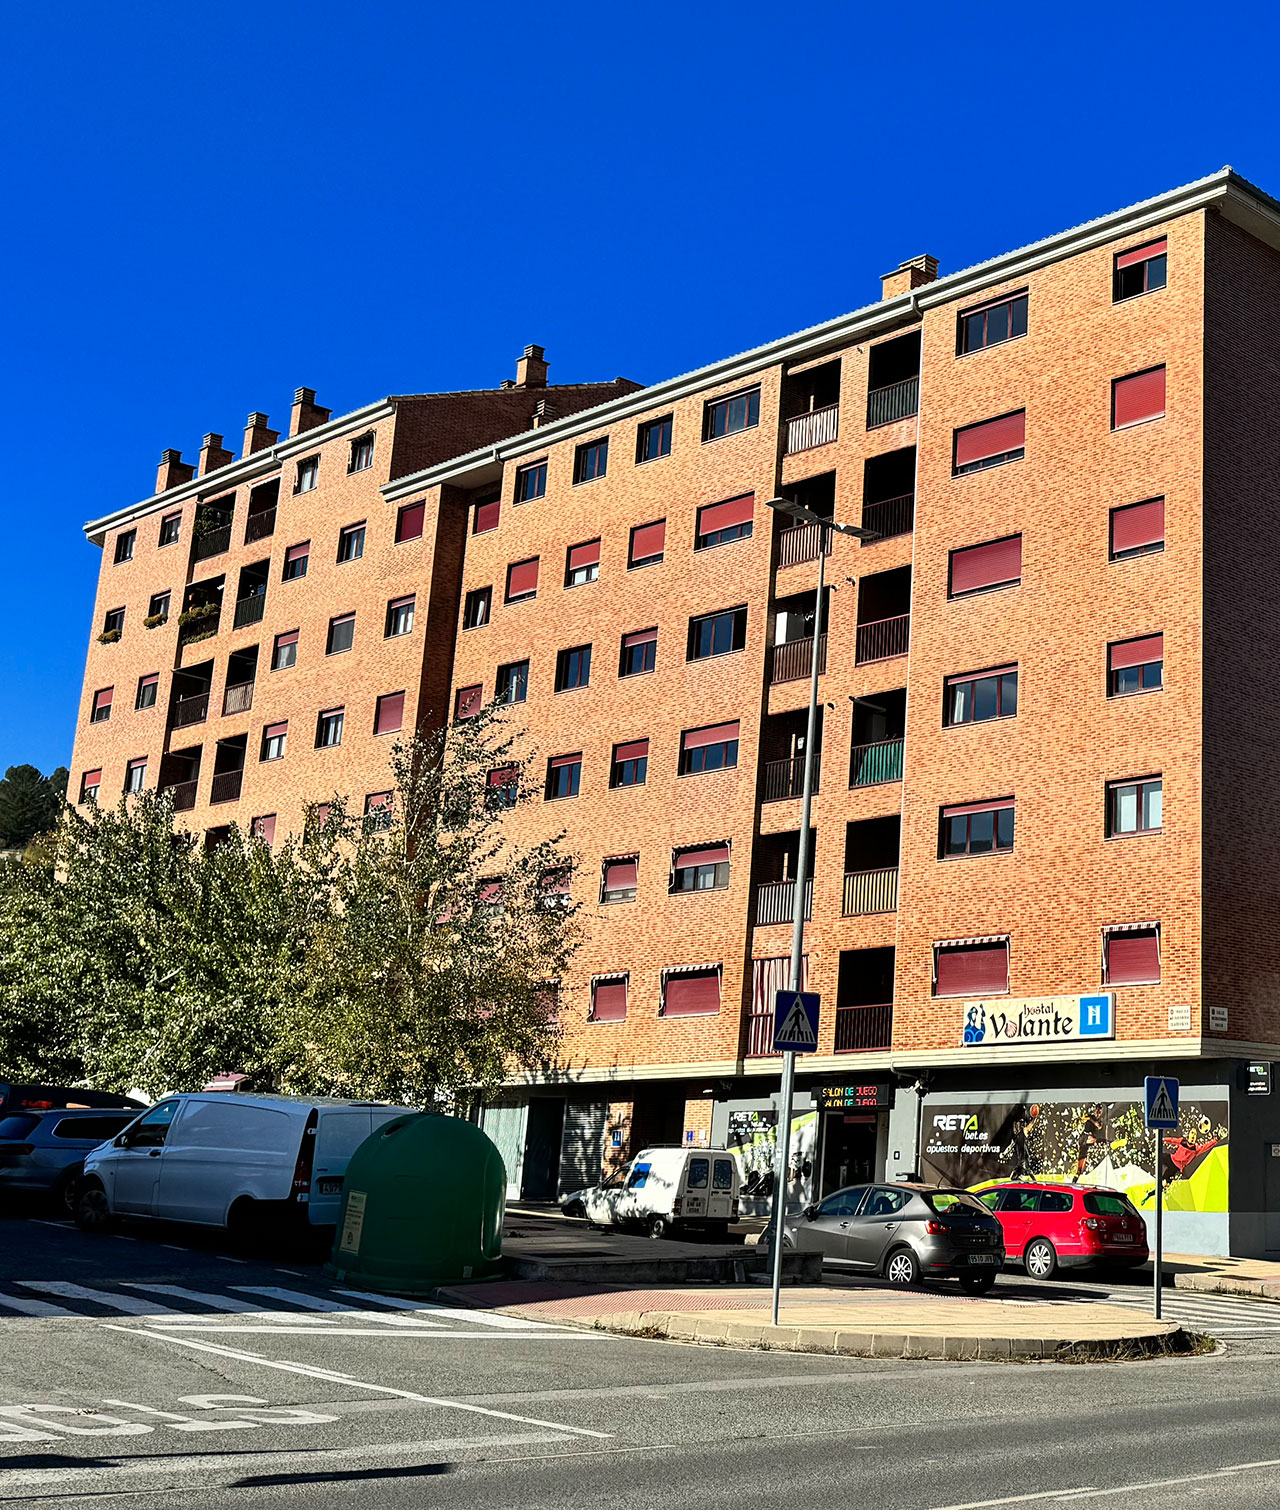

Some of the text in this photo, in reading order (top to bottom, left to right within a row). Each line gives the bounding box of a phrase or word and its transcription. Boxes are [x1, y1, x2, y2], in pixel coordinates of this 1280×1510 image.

[1023, 1002, 1054, 1018] hostal
[990, 1011, 1073, 1039] Volante
[822, 1086, 878, 1097] SALON DE JUEGO
[734, 1112, 759, 1122] RETA
[933, 1114, 978, 1135] RETA
[965, 1131, 989, 1140] bet.es
[926, 1143, 1000, 1155] apuestas deportivas
